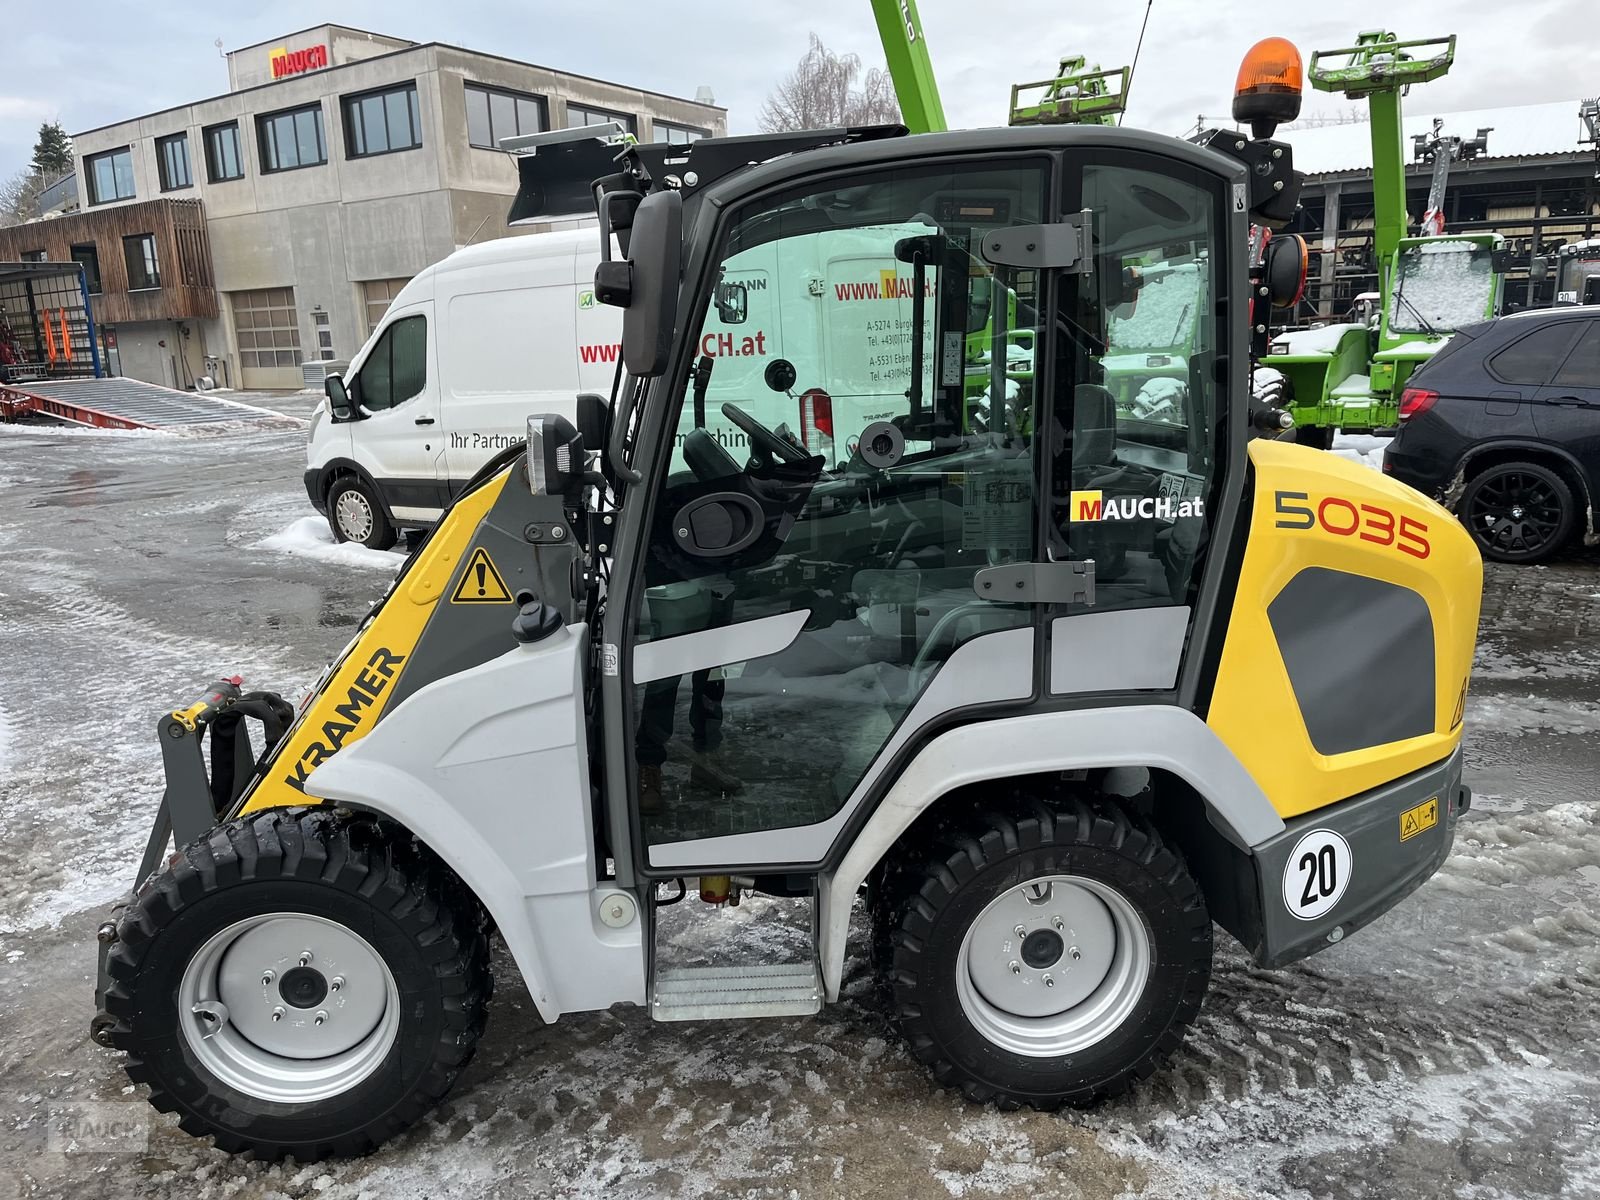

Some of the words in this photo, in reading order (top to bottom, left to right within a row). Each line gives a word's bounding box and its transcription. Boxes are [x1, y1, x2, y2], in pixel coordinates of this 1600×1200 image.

[272, 44, 327, 78] MAUCH
[867, 320, 891, 331] A-5274
[867, 336, 880, 347] Tel.
[869, 354, 893, 366] A-5531
[450, 432, 469, 449] Ihr
[472, 432, 524, 449] Partner
[1079, 496, 1204, 521] MAUCH.at
[1274, 490, 1431, 560] 5035
[284, 647, 406, 796] KRAMER
[1299, 844, 1337, 908] 20
